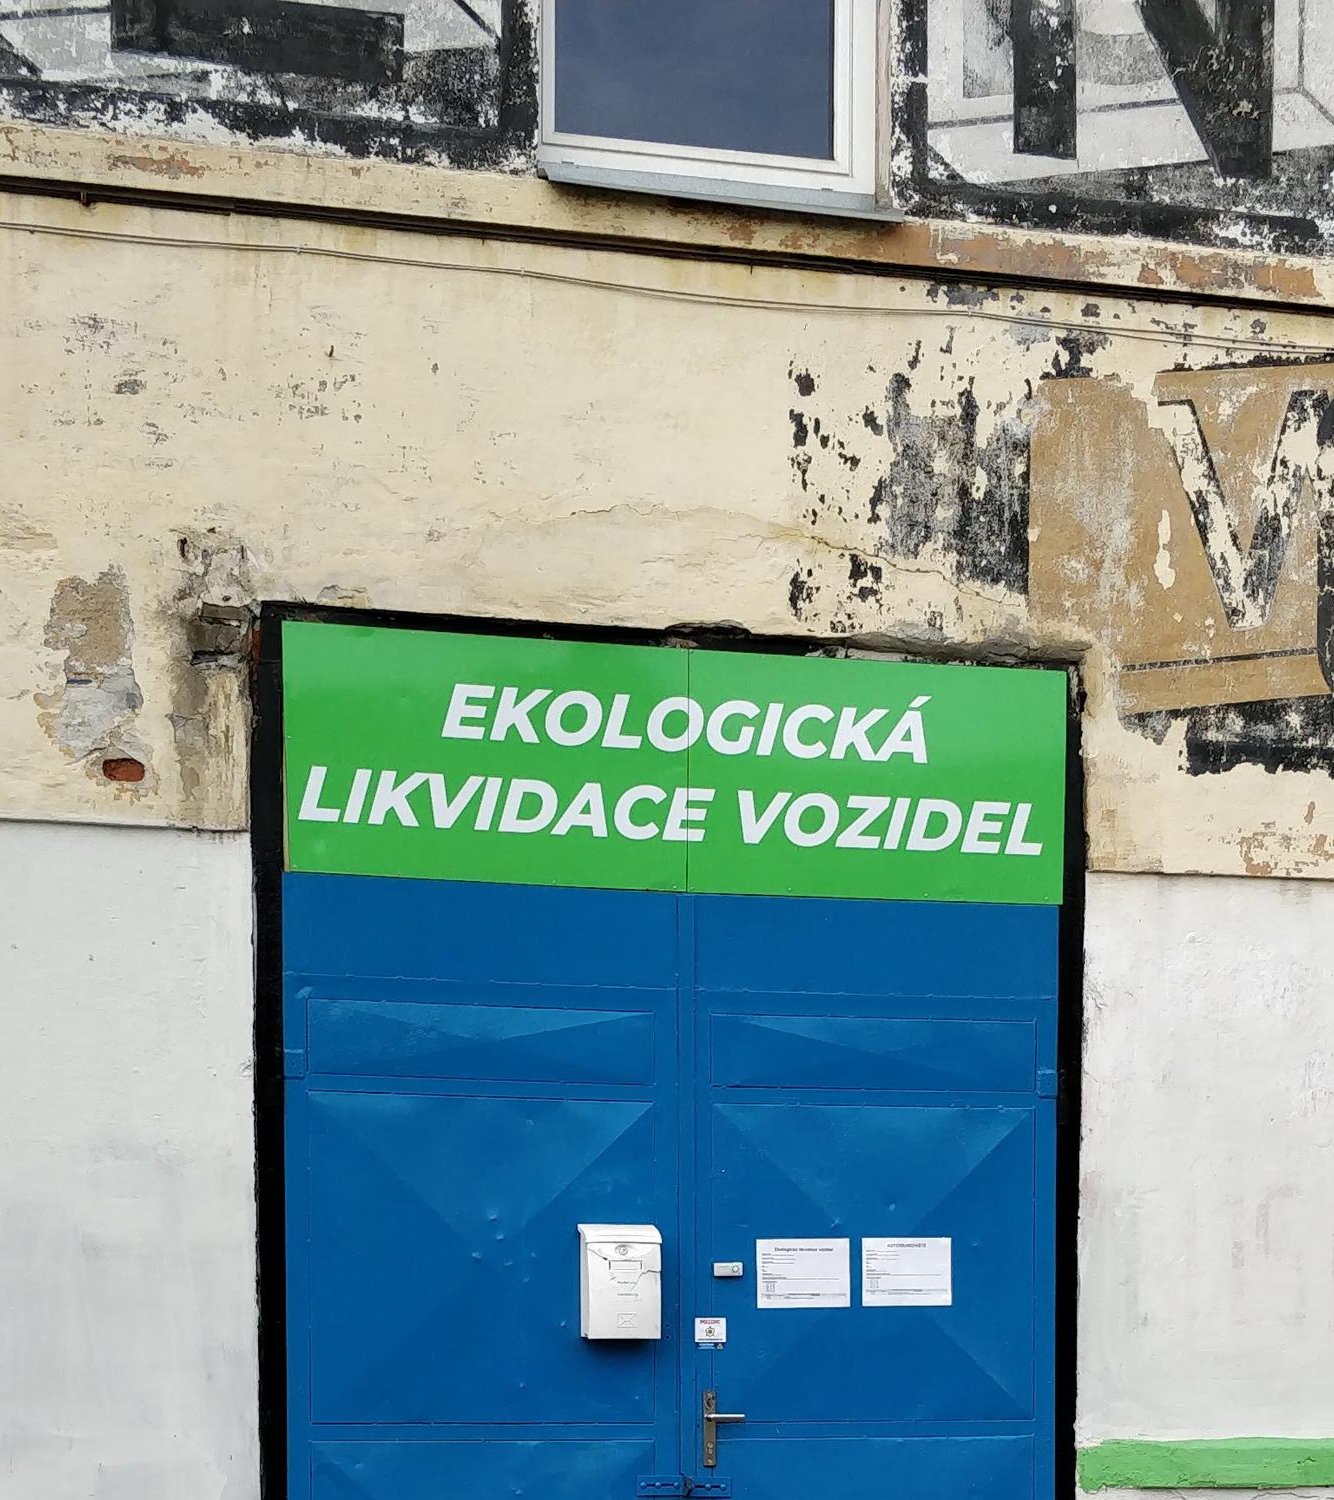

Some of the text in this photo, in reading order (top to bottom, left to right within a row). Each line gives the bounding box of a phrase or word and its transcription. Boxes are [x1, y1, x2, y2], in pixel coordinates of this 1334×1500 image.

[441, 682, 932, 765] EKOLOGICKÁ
[298, 765, 1045, 857] LIKVIDACE VOZIDEL
